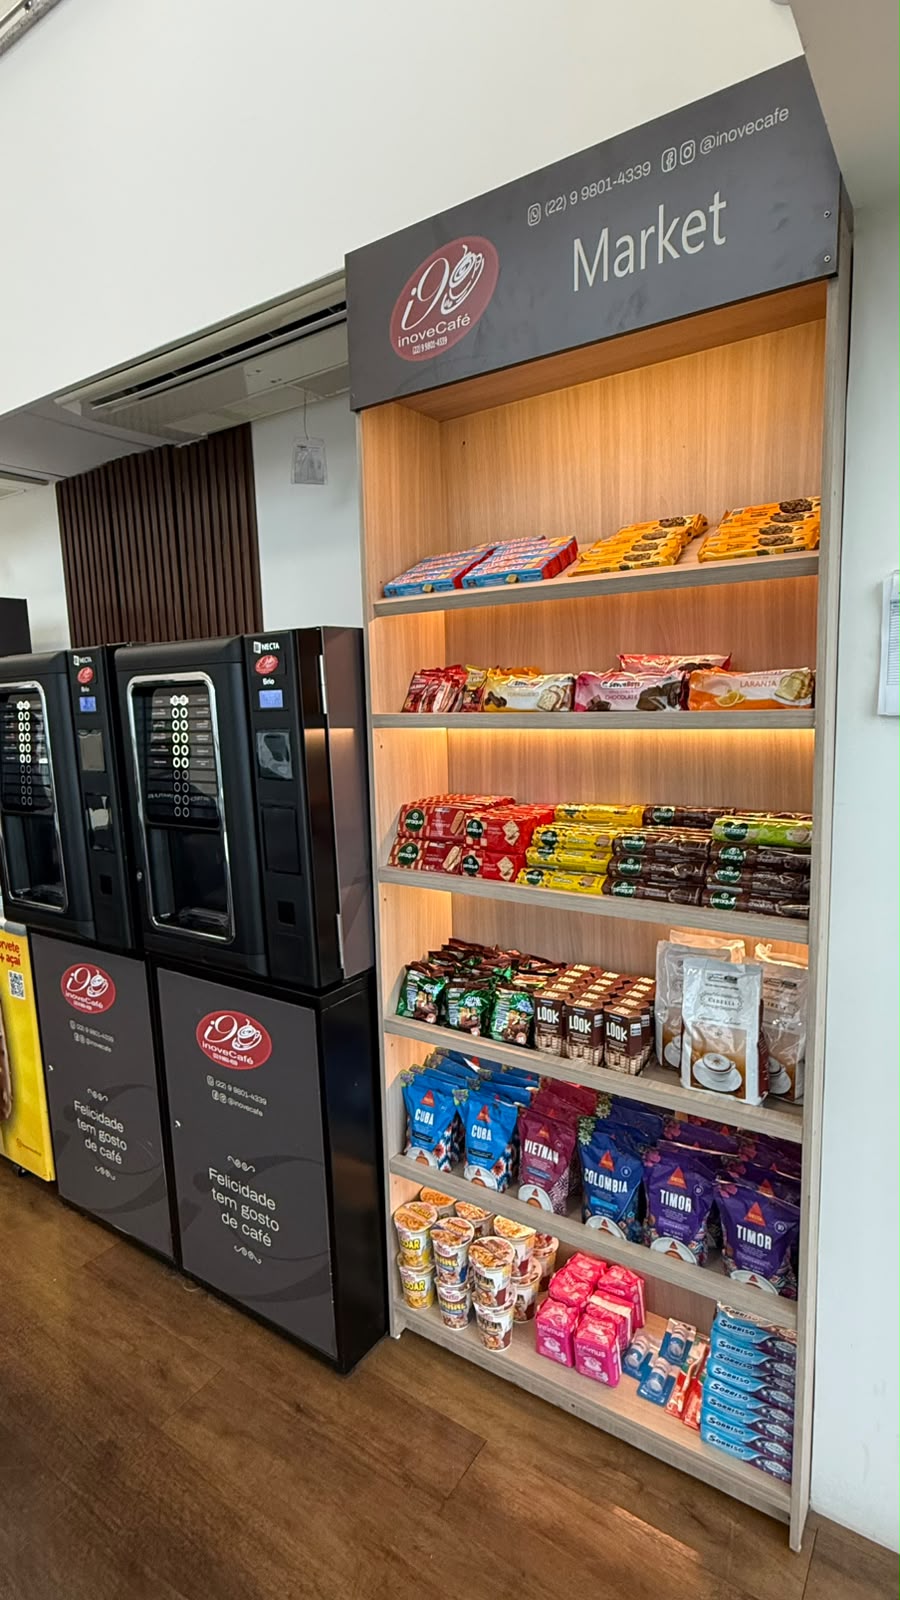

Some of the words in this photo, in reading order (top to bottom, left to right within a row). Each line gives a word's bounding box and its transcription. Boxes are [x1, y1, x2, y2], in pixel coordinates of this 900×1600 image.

[544, 195, 567, 217] (22)
[569, 191, 578, 205] 9
[580, 161, 651, 201] 9801-4339
[699, 107, 789, 155] @inovecafe
[572, 191, 726, 292] Market
[398, 313, 471, 347] inoveCafé
[261, 642, 280, 651] NECTA
[739, 679, 777, 689] LARANJA
[537, 1005, 560, 1025] LOOK
[569, 1014, 592, 1035] LOOK
[605, 1021, 628, 1042] LOOK
[201, 1041, 254, 1065] inoveCafé
[73, 1100, 125, 1133] Felicidade
[414, 1108, 435, 1126] CUBA
[76, 1118, 97, 1136] tem
[98, 1130, 128, 1151] gosto
[471, 1124, 492, 1142] CUBA
[84, 1138, 98, 1152] de
[99, 1146, 122, 1165] café
[524, 1138, 559, 1165] VIETNAM
[208, 1167, 276, 1210] Felicidade
[584, 1167, 628, 1193] COLOMBIA
[211, 1187, 238, 1211] tem
[241, 1205, 280, 1232] gosto
[660, 1189, 692, 1213] TIMOR
[221, 1212, 238, 1229] de
[241, 1223, 272, 1247] café
[736, 1223, 773, 1251] TIMOR
[719, 1319, 755, 1336] SORRISO
[711, 1383, 749, 1401] SORRISO
